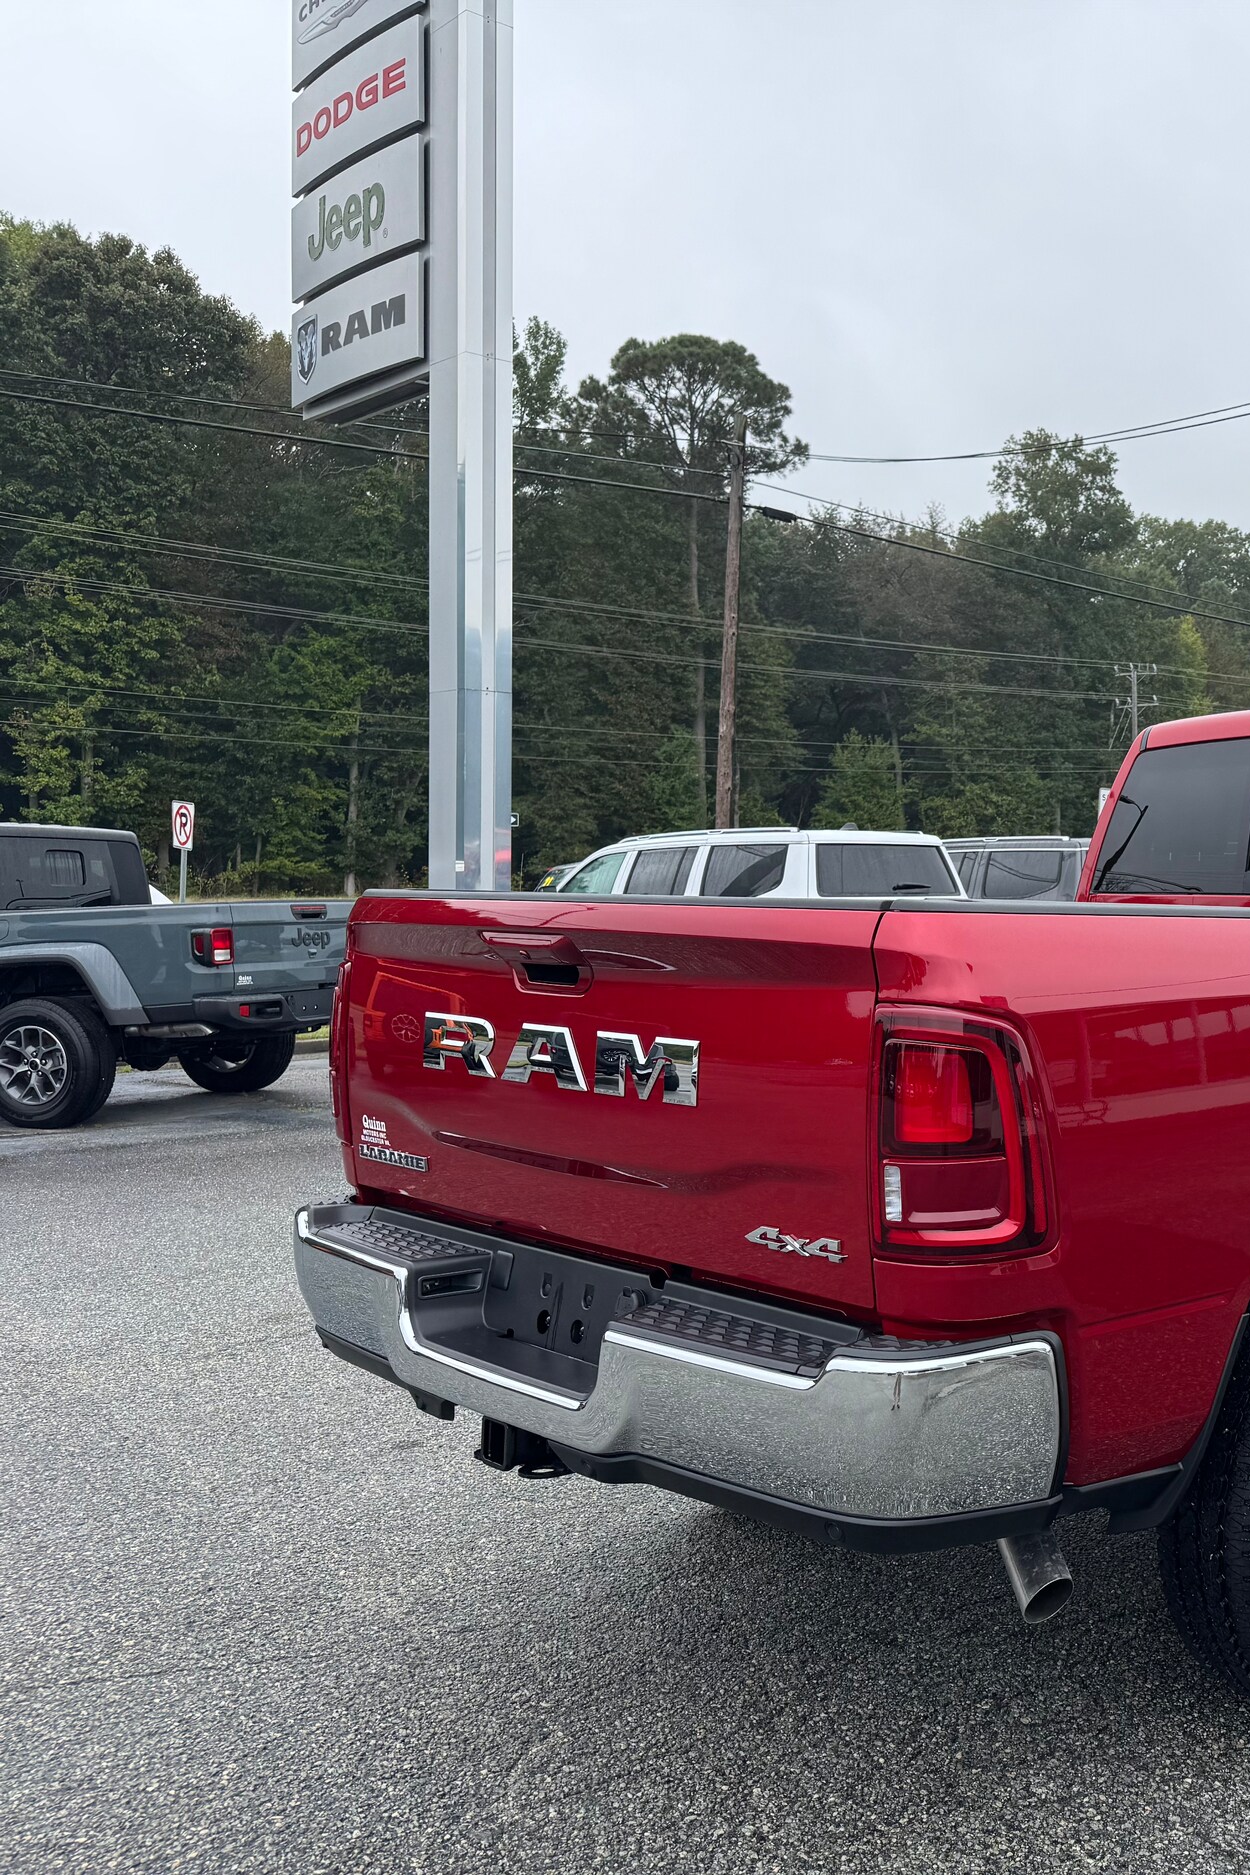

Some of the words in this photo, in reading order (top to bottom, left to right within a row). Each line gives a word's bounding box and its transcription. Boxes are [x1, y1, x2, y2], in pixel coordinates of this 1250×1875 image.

[299, 0, 325, 22] CH
[296, 58, 406, 158] DODGE
[307, 182, 386, 262] Jeep
[321, 293, 406, 357] RAM
[291, 928, 331, 950] Jeep
[423, 1011, 700, 1107] RAM
[362, 1114, 386, 1132] Quinn
[359, 1143, 428, 1172] LARAMIE
